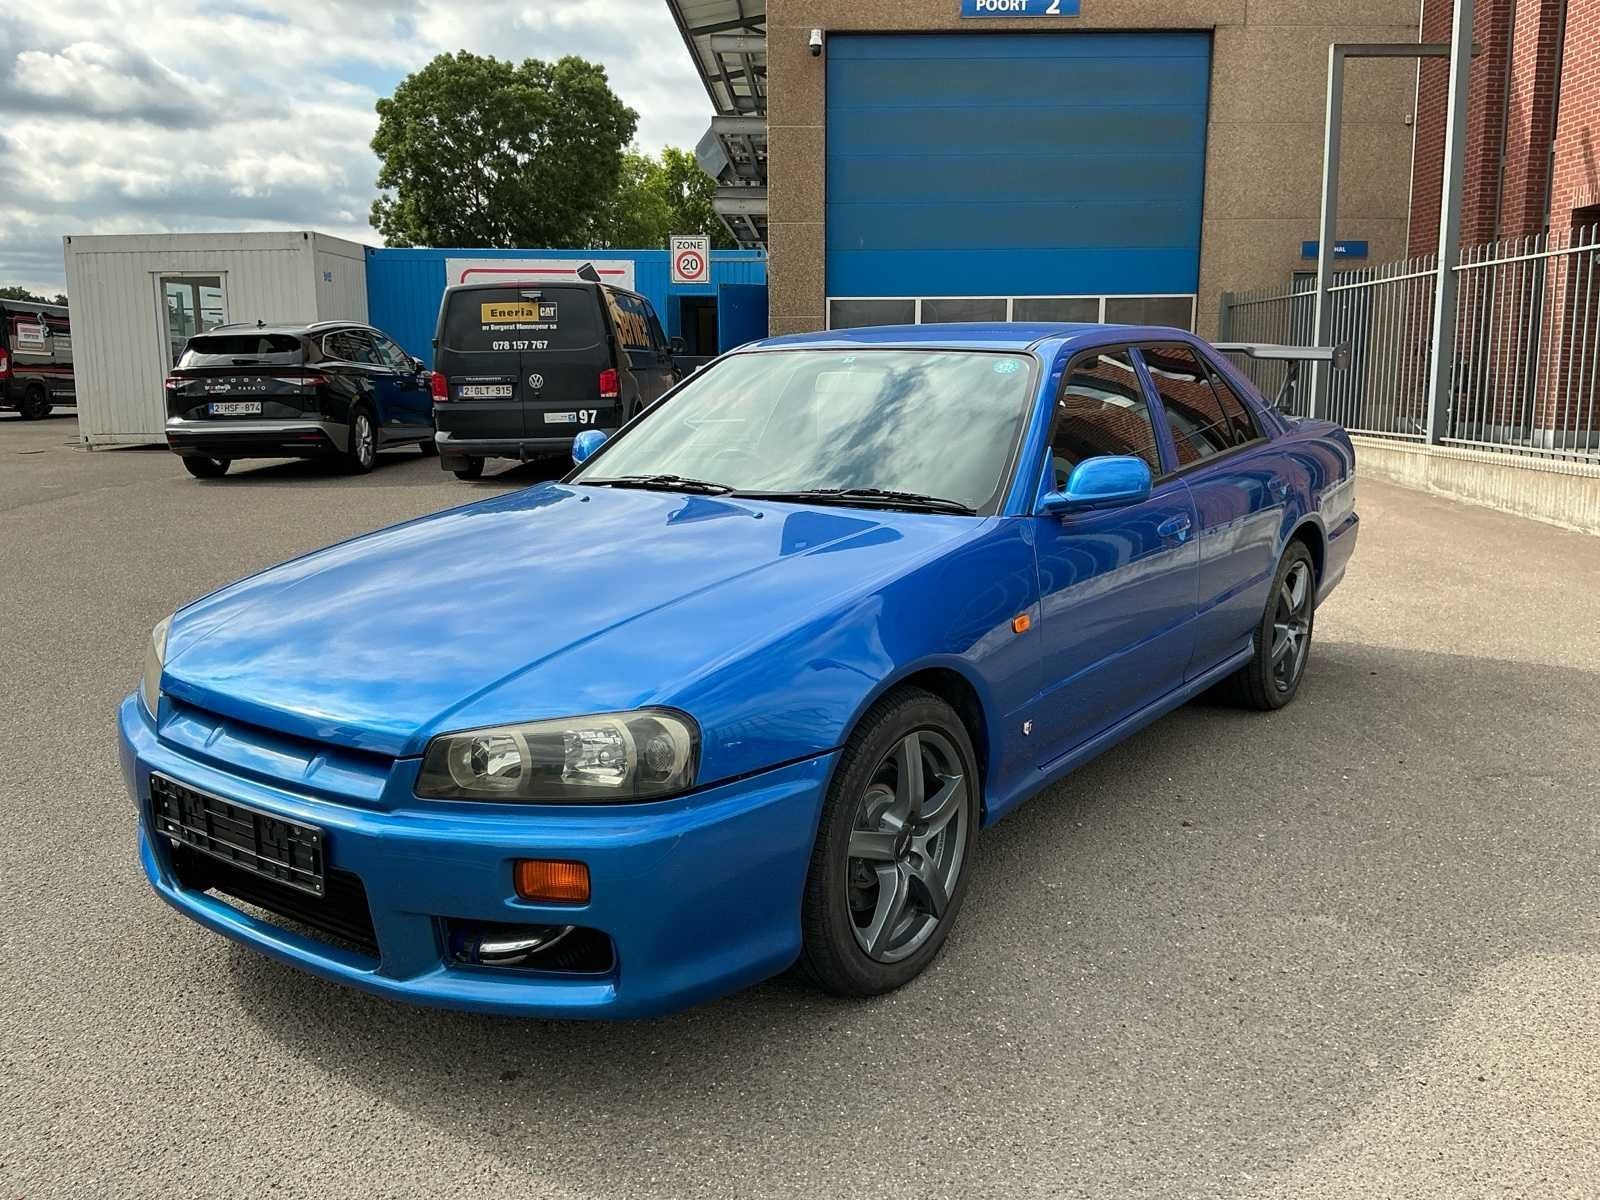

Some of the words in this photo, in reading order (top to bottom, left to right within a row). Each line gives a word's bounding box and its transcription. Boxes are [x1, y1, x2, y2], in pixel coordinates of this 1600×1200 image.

[976, 0, 1027, 11] POORT
[1045, 0, 1060, 15] 2
[676, 241, 703, 249] ZONE
[682, 258, 698, 270] 20
[490, 307, 533, 317] Eneria
[540, 306, 555, 317] CAT
[492, 341, 510, 350] 078
[512, 341, 528, 350] 157
[531, 340, 548, 349] 767
[578, 409, 597, 424] 97
